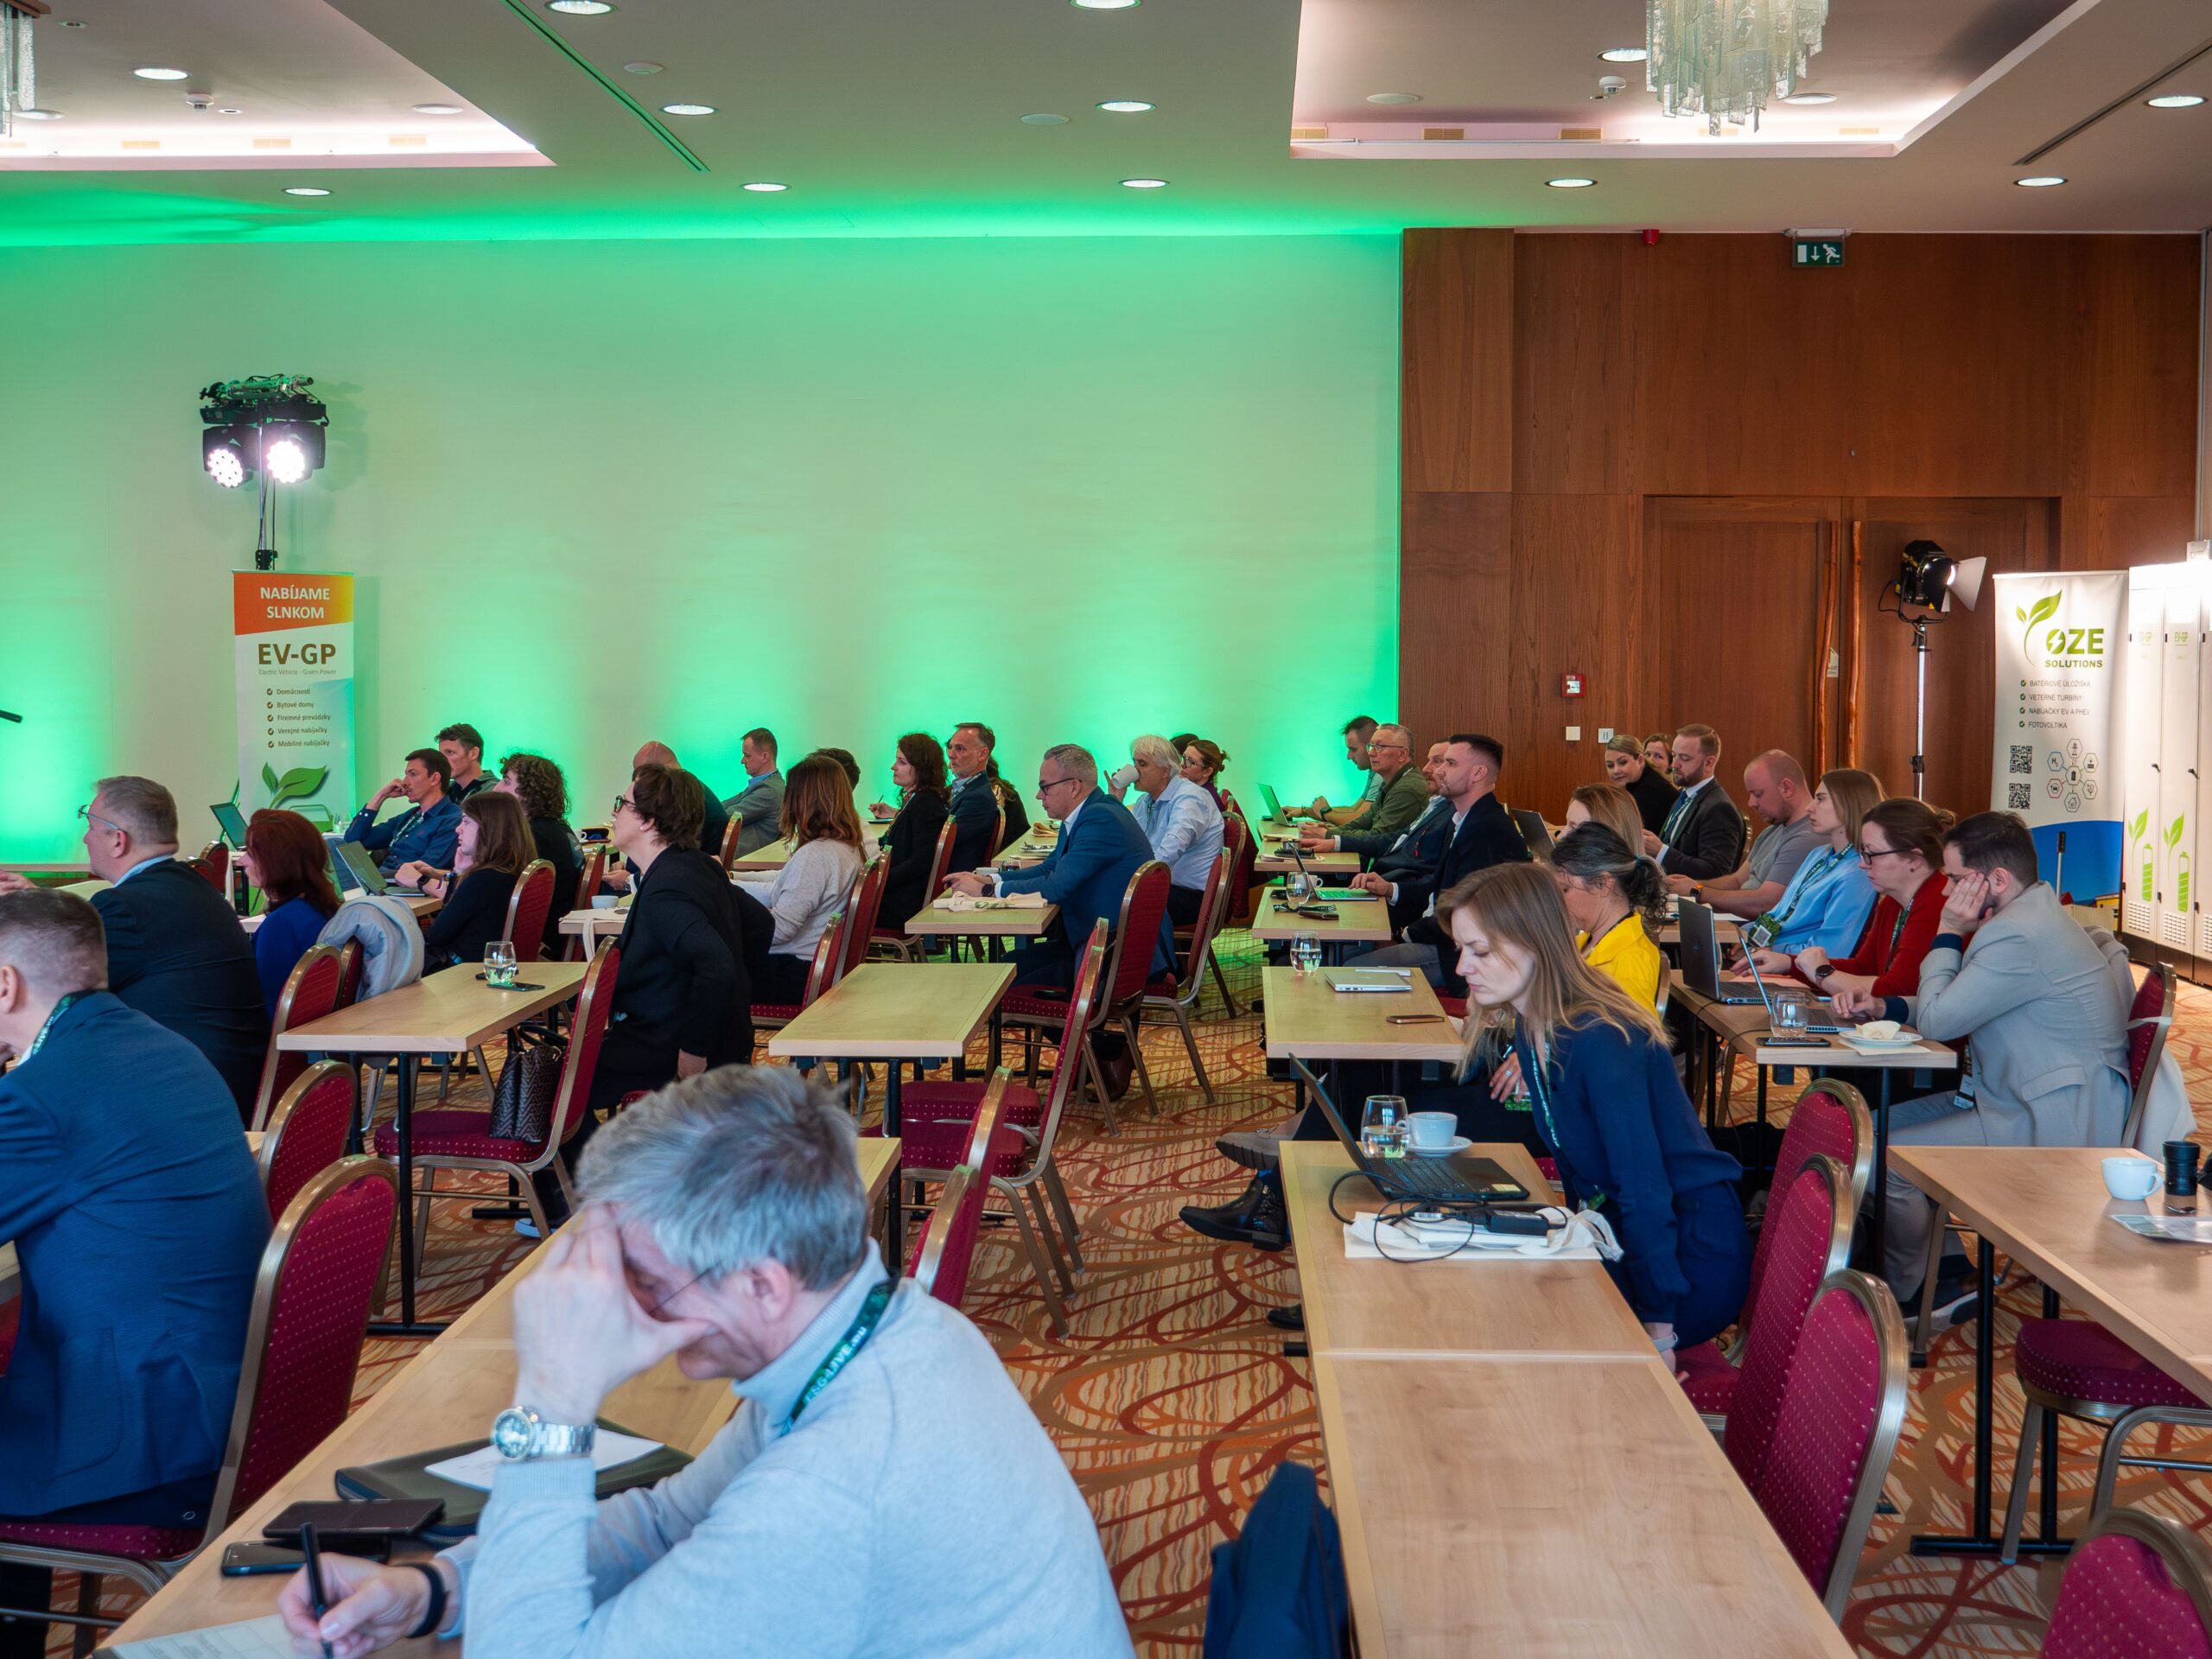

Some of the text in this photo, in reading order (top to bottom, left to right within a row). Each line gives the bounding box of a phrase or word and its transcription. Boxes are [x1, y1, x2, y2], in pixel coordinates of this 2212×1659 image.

[260, 584, 330, 600] NABÍJAME
[266, 606, 324, 619] SLNKOM
[2046, 628, 2104, 654] OZE
[258, 643, 336, 664] EV-GP
[2045, 659, 2103, 668] SOLUTIONS
